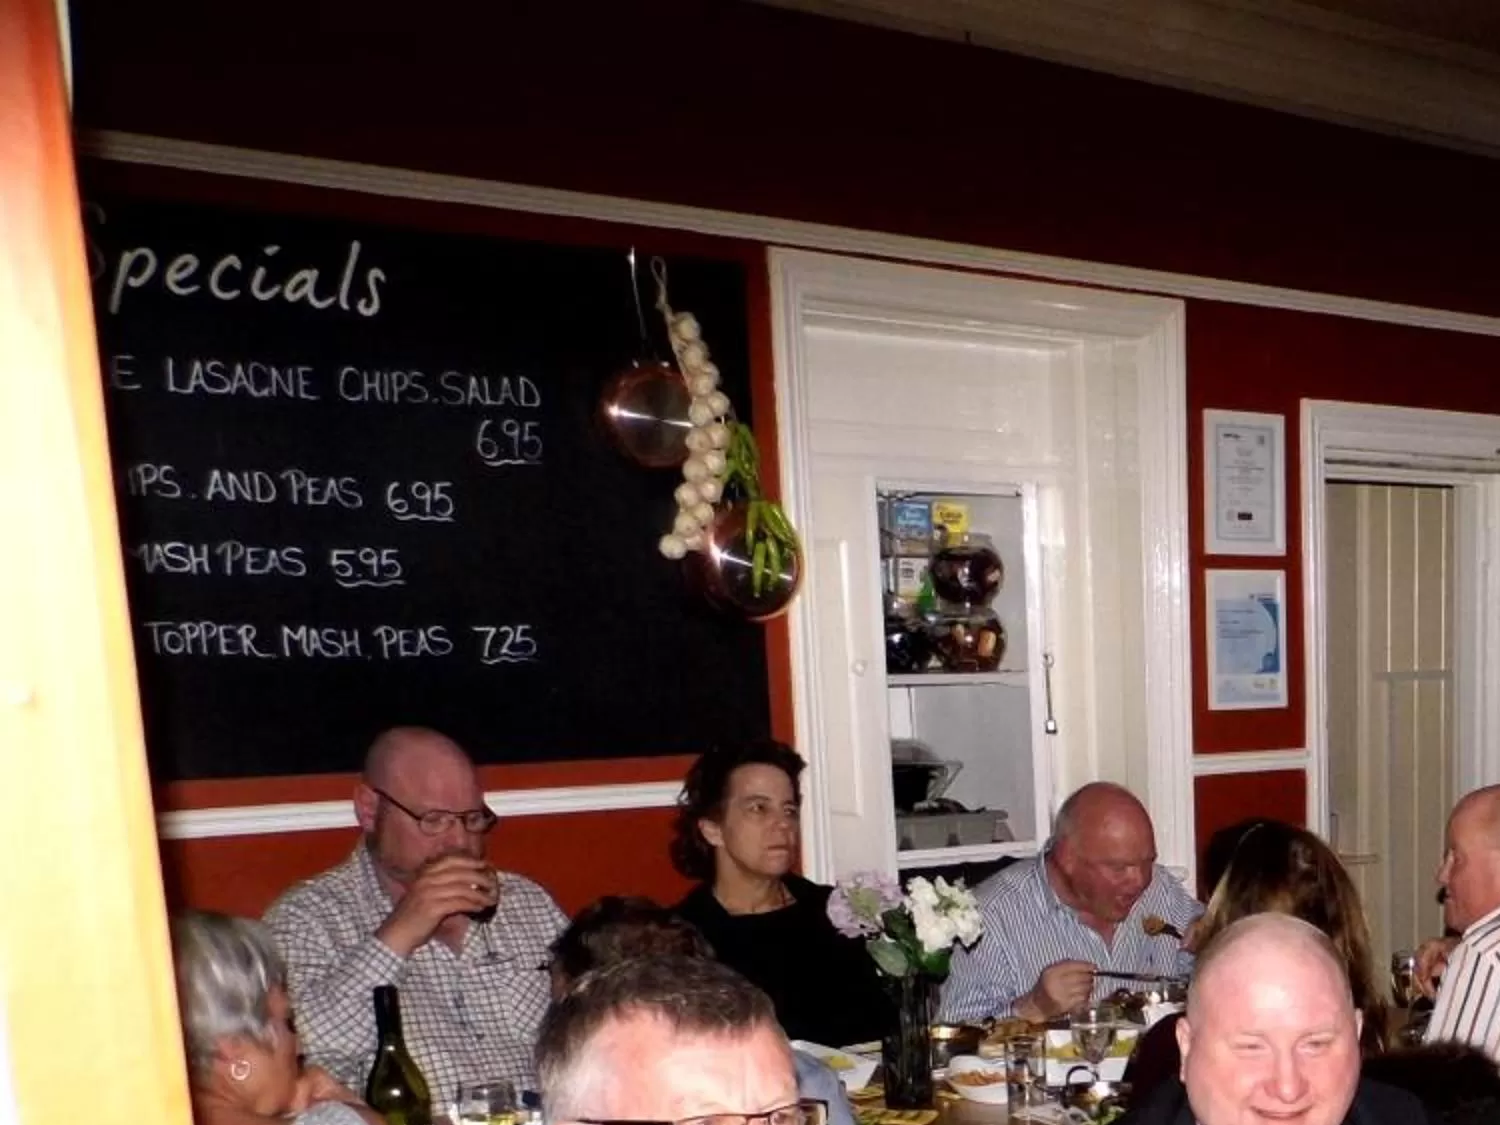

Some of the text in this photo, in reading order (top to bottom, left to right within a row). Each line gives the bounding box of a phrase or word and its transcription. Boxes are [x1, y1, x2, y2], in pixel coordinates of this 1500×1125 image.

[204, 468, 278, 505] AND
[280, 468, 364, 510] PEAS
[214, 539, 308, 578] PEAS
[372, 624, 456, 660] PEAS
